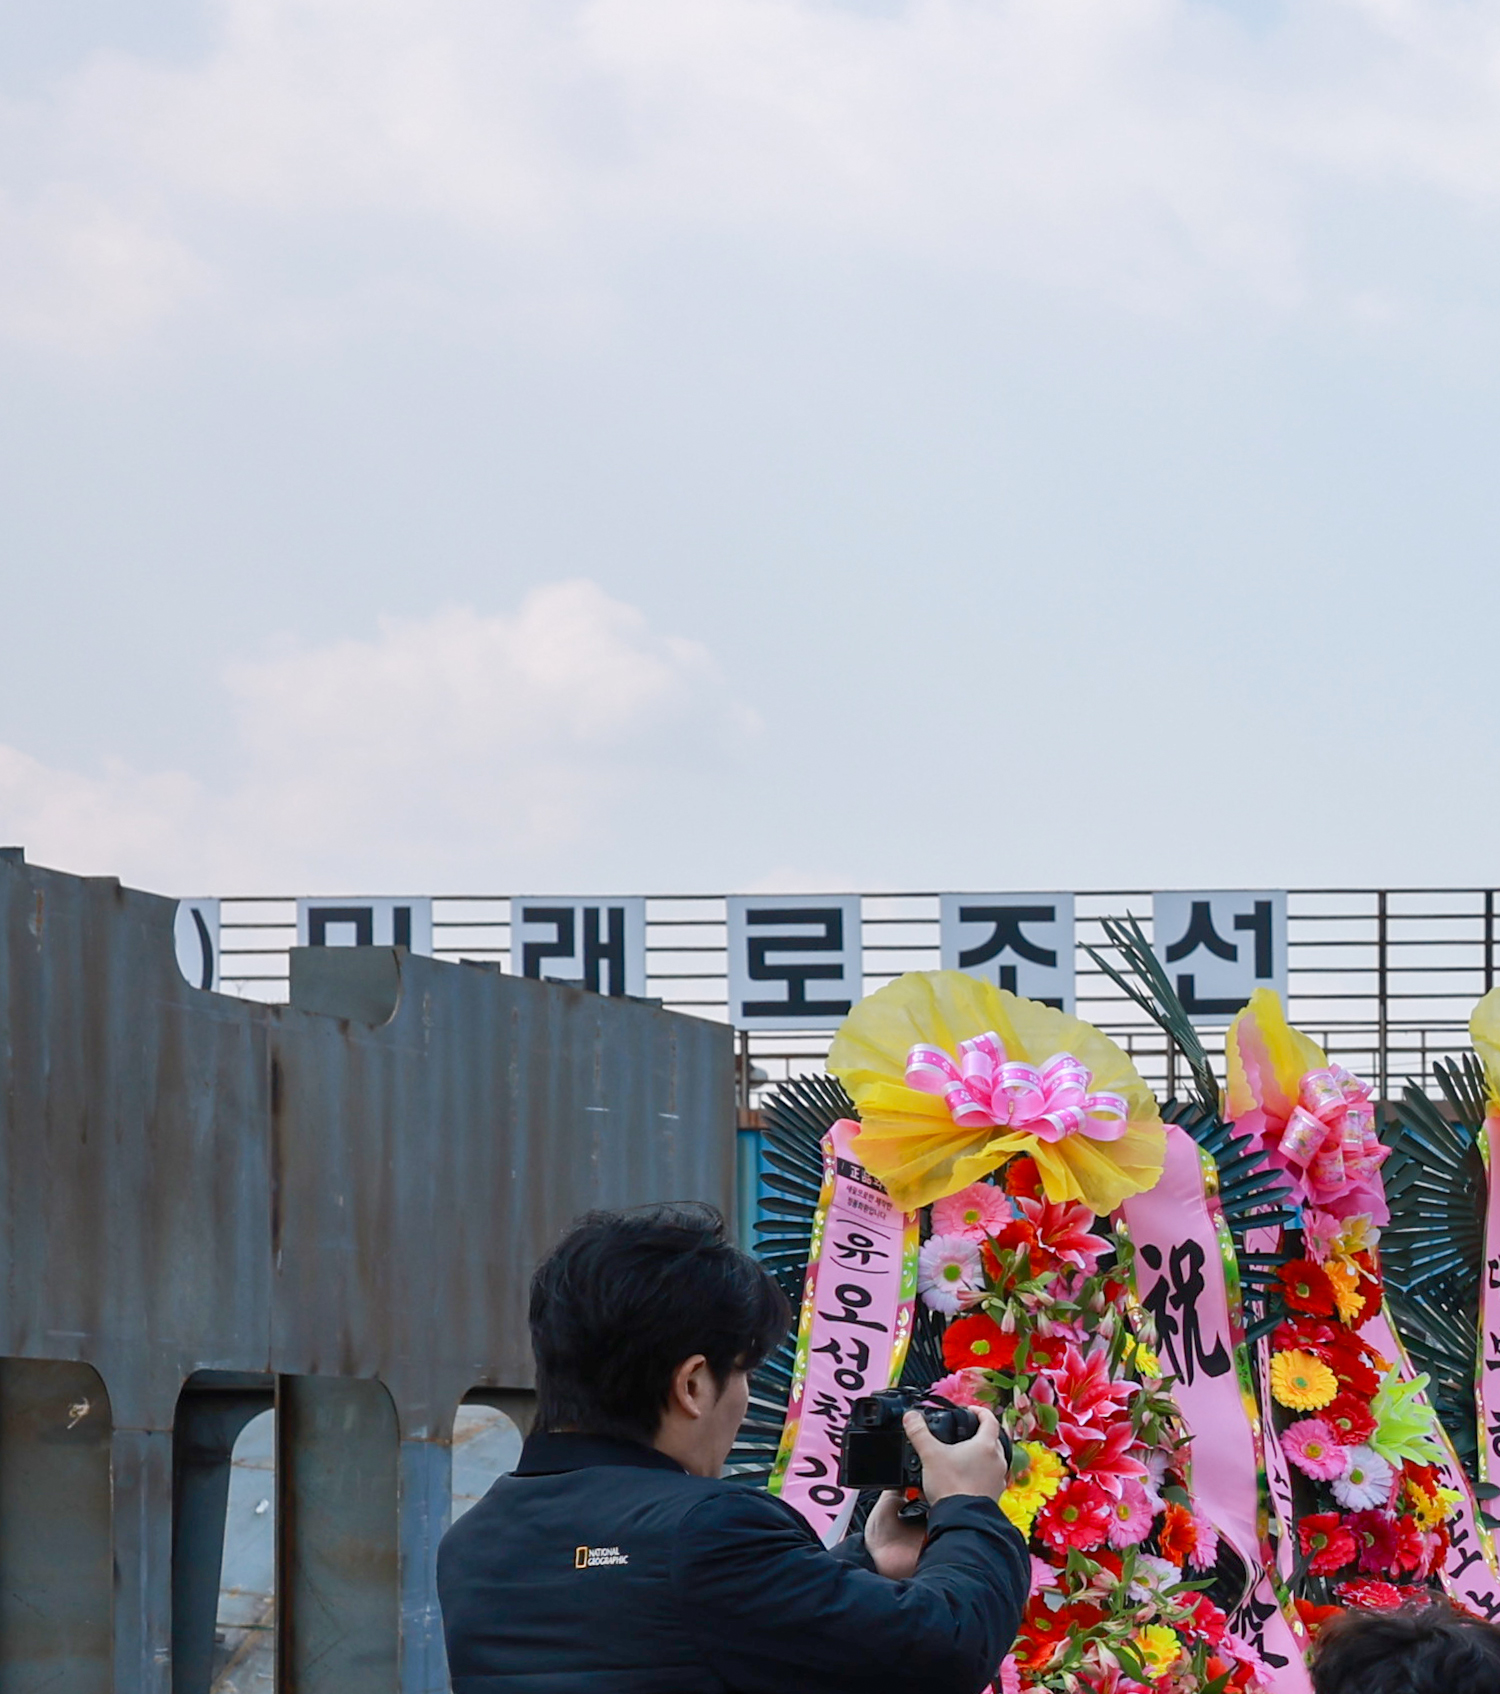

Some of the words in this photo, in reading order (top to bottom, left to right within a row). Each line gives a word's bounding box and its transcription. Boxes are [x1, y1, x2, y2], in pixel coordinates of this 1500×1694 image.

[1139, 1238, 1231, 1387] 祝
[588, 1546, 620, 1557] NATIONAL
[587, 1555, 629, 1567] GEOGRAPHIC
